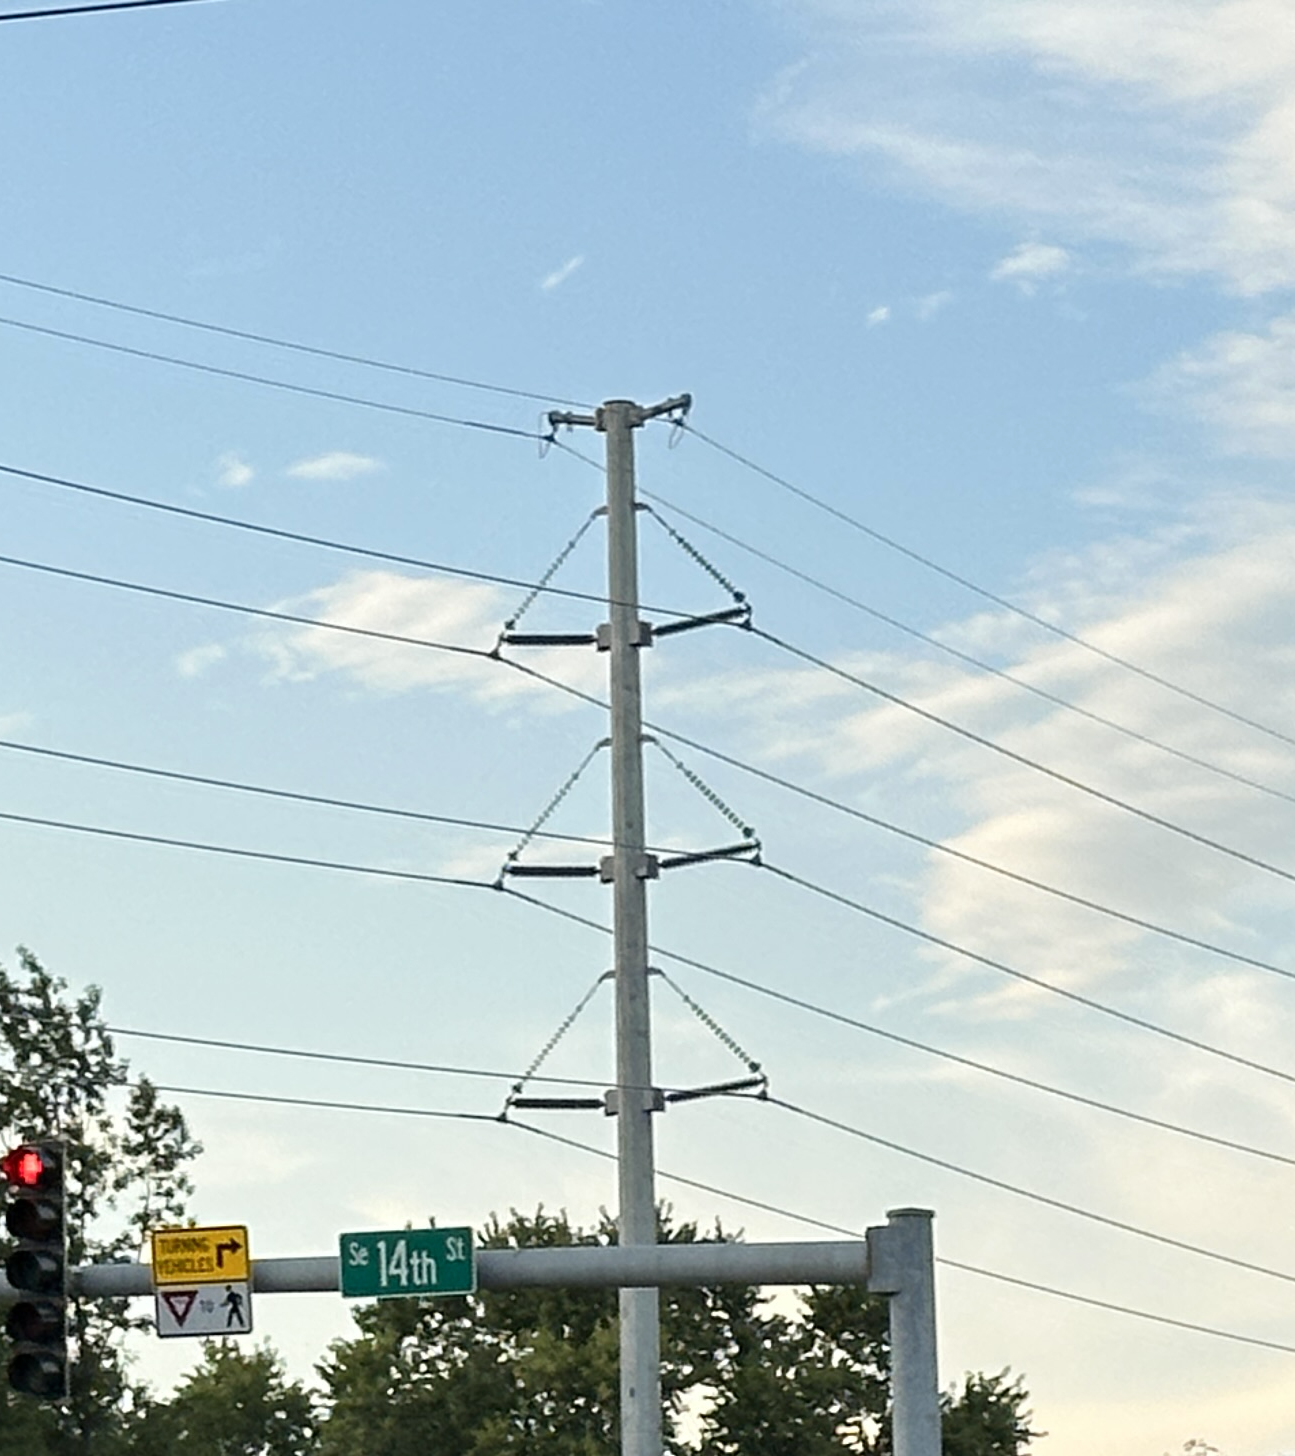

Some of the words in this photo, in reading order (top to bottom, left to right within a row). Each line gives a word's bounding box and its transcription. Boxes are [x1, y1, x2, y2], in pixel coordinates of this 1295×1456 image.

[158, 1256, 215, 1275] VEHICLES
[377, 1239, 438, 1287] 14th
[446, 1236, 466, 1261] St
